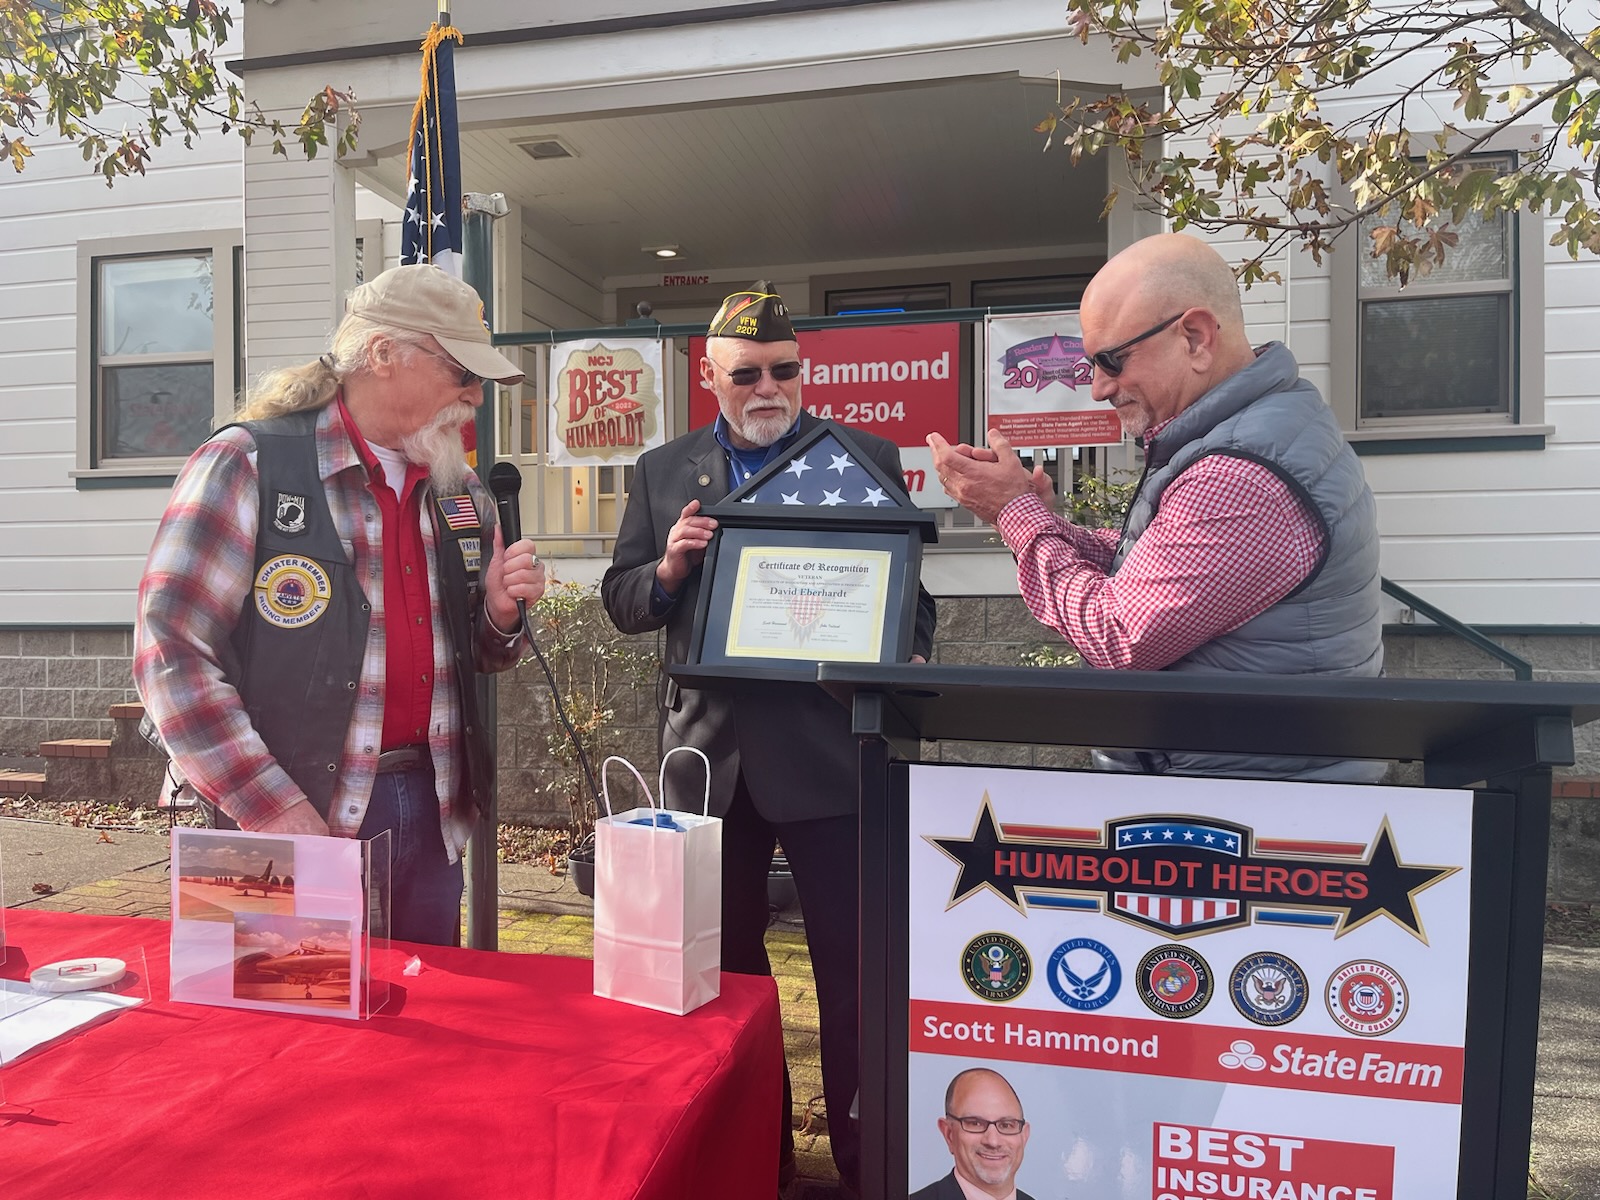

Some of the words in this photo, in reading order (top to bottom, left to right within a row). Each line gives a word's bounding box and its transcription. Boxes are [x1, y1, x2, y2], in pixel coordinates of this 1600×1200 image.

[664, 276, 709, 286] ENTRANCE
[736, 326, 758, 336] 2207
[740, 316, 758, 326] VFW
[588, 356, 614, 366] NCJ
[1014, 343, 1048, 356] Reader's
[1004, 366, 1040, 390] 20
[1074, 362, 1094, 386] 2
[567, 369, 644, 424] BEST
[615, 402, 632, 410] 2022
[594, 406, 608, 420] OF
[566, 411, 646, 449] HUMBOLDT
[262, 559, 298, 582] CHARTER
[300, 561, 326, 592] MEMBER
[759, 561, 800, 571] Certificate
[803, 562, 814, 571] Of
[818, 563, 869, 574] Recognition
[770, 587, 798, 596] David
[800, 588, 847, 598] Eberhardt
[259, 596, 281, 622] RIDING
[282, 604, 322, 624] MEMBER
[994, 850, 1203, 888] HUMBOLDT
[1212, 864, 1370, 900] HEROES
[969, 936, 998, 955] UNITED
[998, 937, 1024, 960] STATES
[1052, 940, 1084, 962] UNITED
[1087, 941, 1116, 966] STATES
[1145, 951, 1178, 972] UNITED
[1178, 952, 1206, 982] STATES
[1234, 957, 1265, 992] UNITED
[1276, 958, 1303, 998] STATES
[1337, 964, 1366, 983] UNITED
[1369, 965, 1398, 987] STATES
[984, 990, 1010, 999] ARMY
[1055, 990, 1073, 1007] AIR
[1077, 995, 1112, 1009] FORCE
[1146, 990, 1178, 1013] MARINE
[1178, 991, 1205, 1013] CORPS
[1252, 1010, 1284, 1022] NAVY
[1338, 1014, 1367, 1033] COAST
[1368, 1016, 1396, 1033] GUARD
[922, 1016, 996, 1044] Scott
[1004, 1024, 1160, 1060] Hammond
[1158, 1125, 1304, 1172] BEST
[1157, 1166, 1378, 1200] INSURANCE
